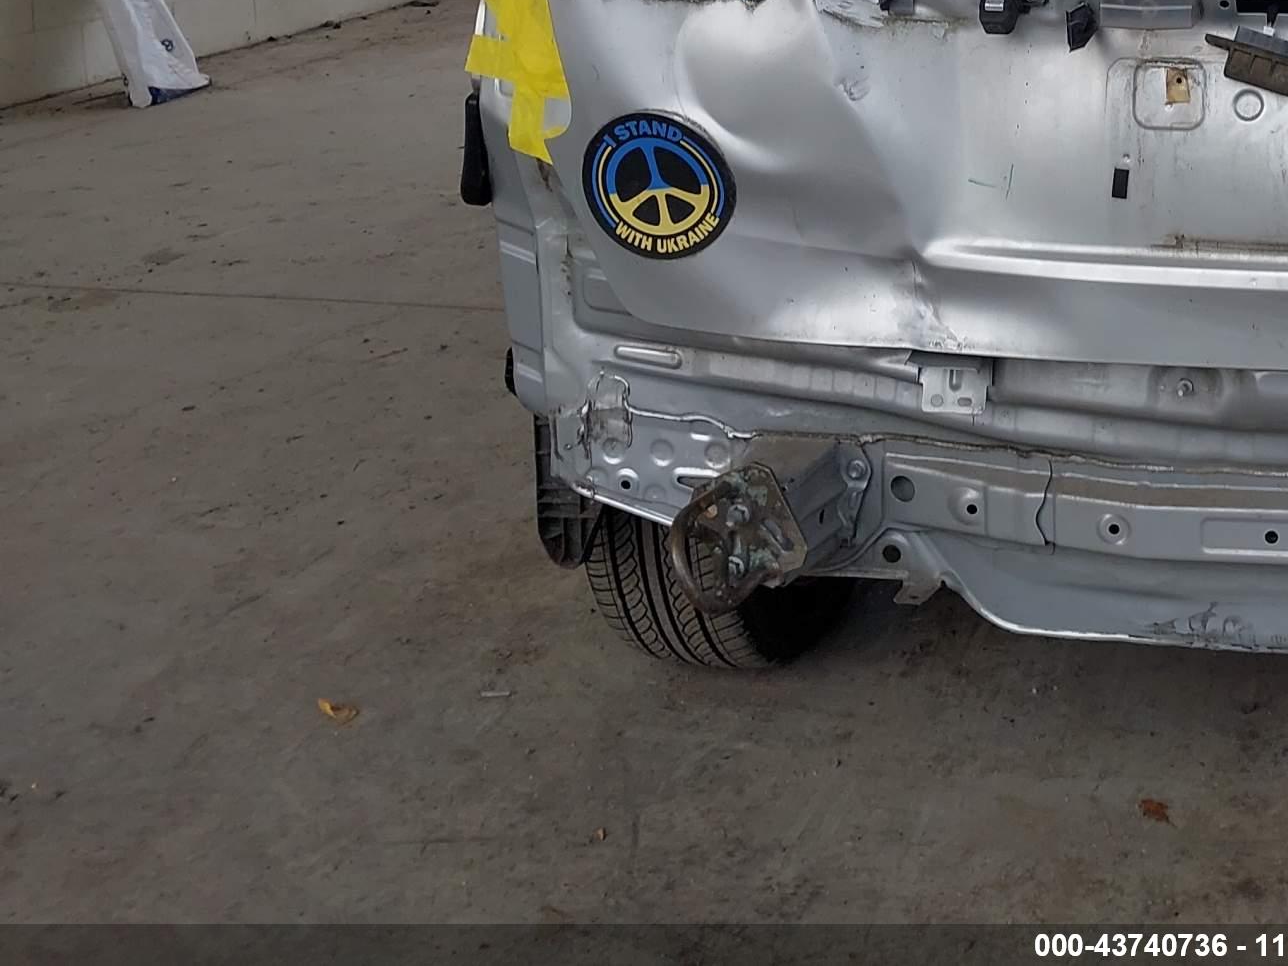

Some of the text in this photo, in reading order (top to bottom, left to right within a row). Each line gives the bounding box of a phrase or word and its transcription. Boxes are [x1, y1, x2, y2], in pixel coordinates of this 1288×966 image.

[602, 120, 682, 148] I STAND
[615, 212, 720, 254] WITH UKRAINE
